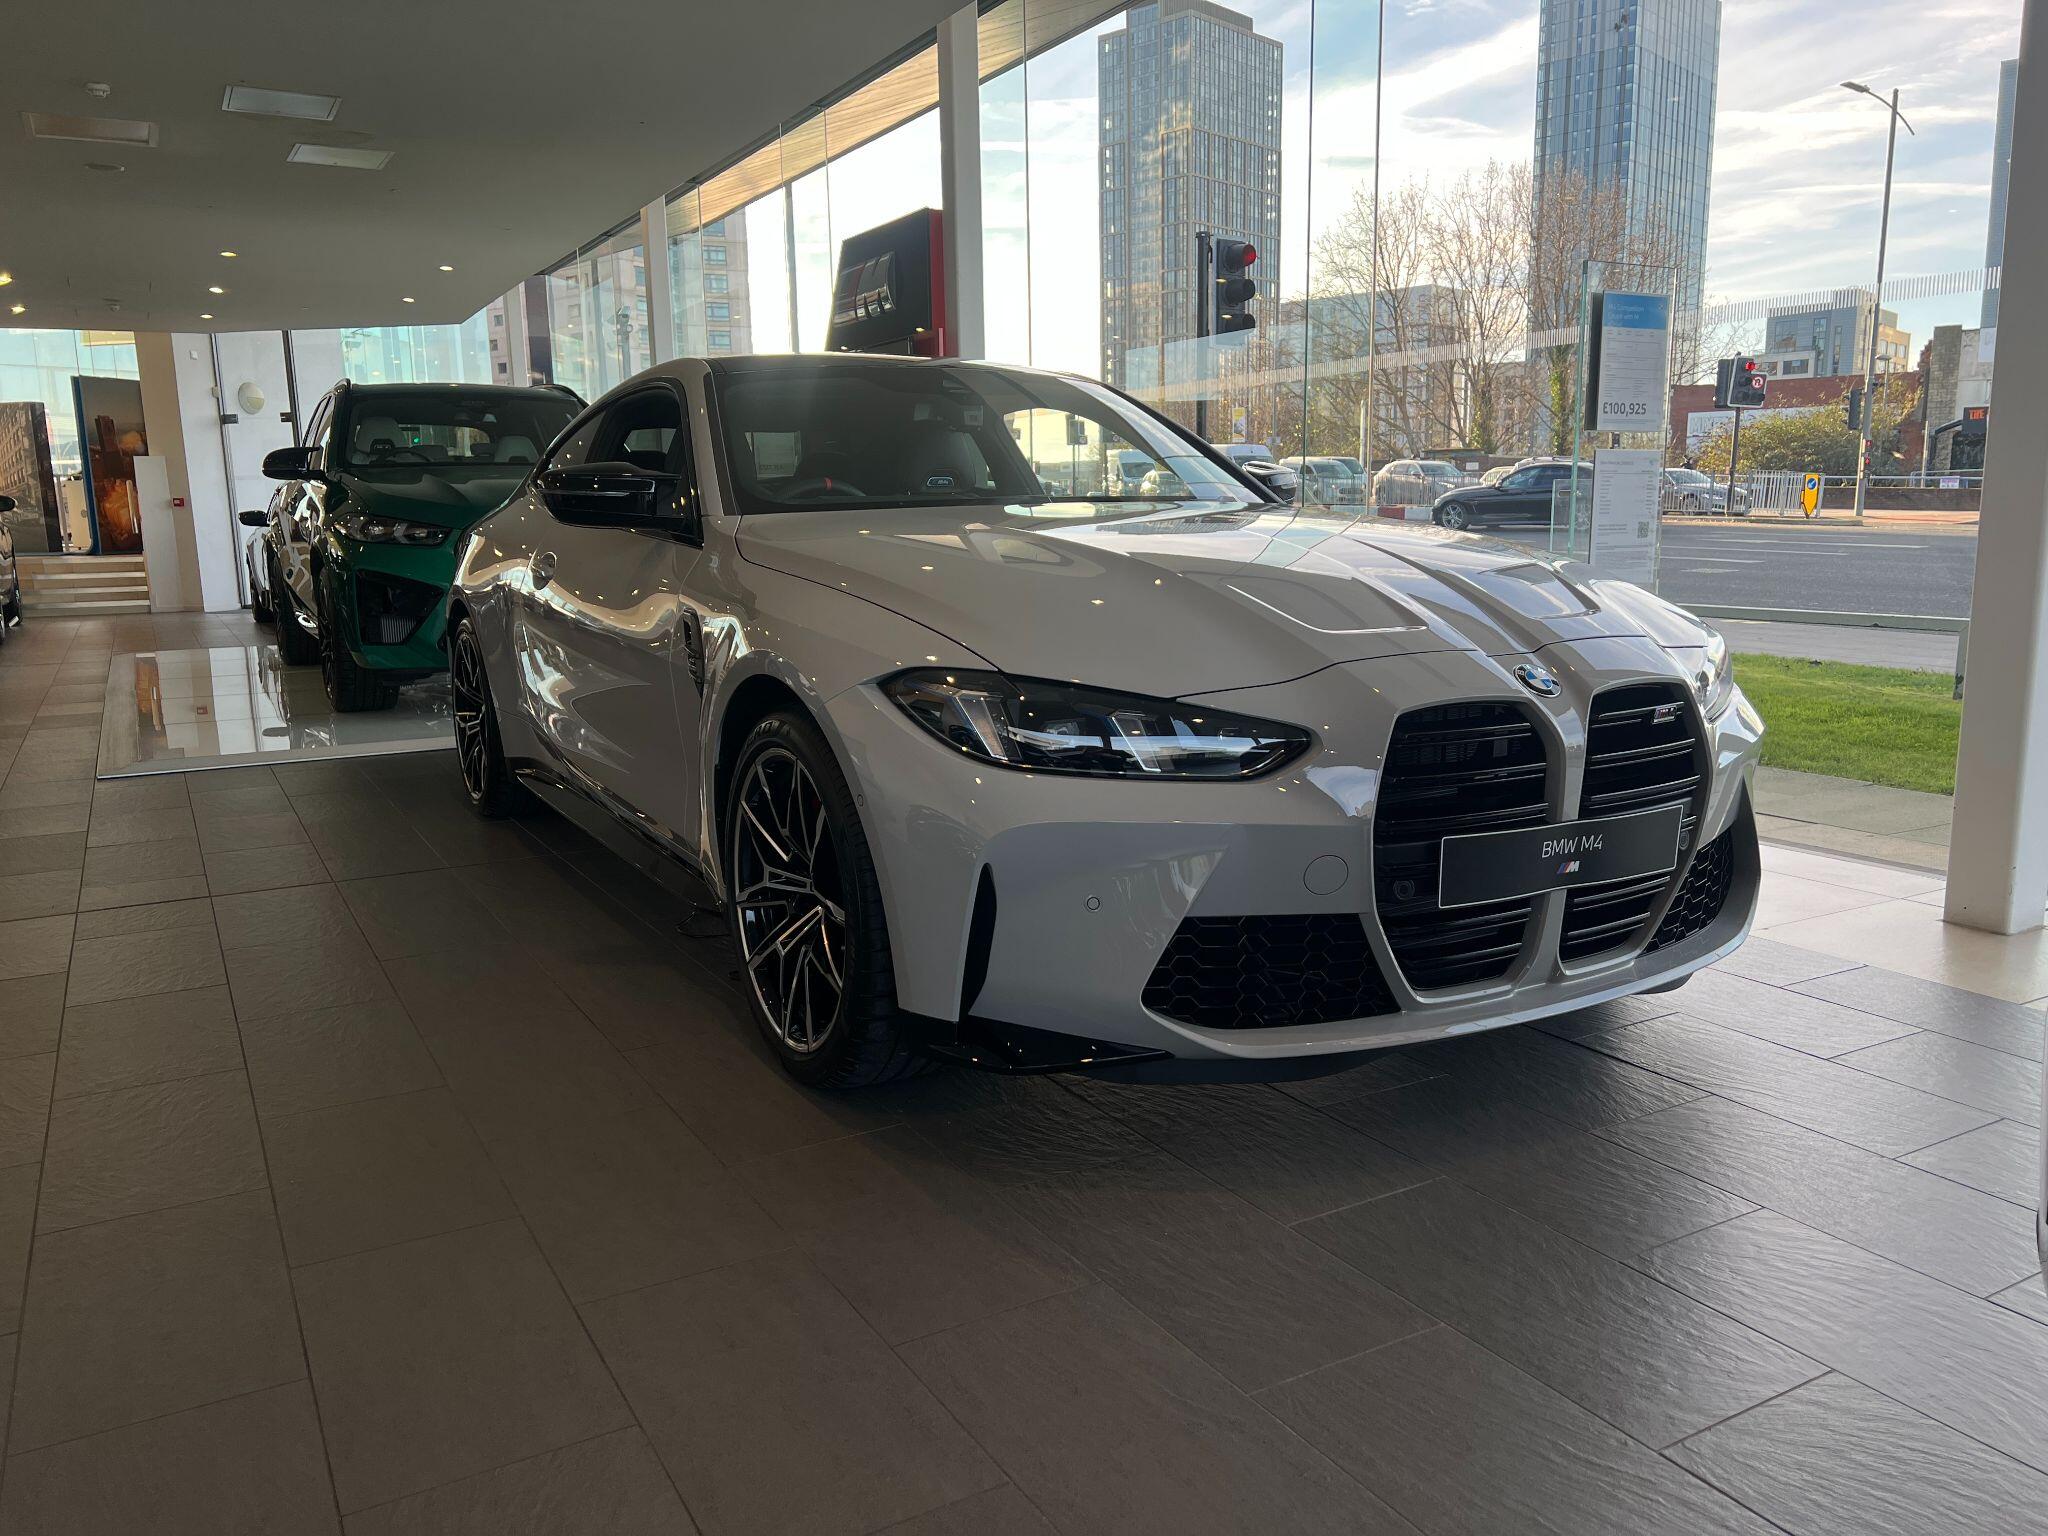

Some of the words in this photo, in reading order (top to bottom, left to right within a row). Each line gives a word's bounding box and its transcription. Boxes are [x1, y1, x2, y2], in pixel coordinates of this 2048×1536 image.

[1603, 401, 1647, 417] £100,925
[1541, 836, 1579, 858] BMW
[1580, 834, 1603, 852] M4
